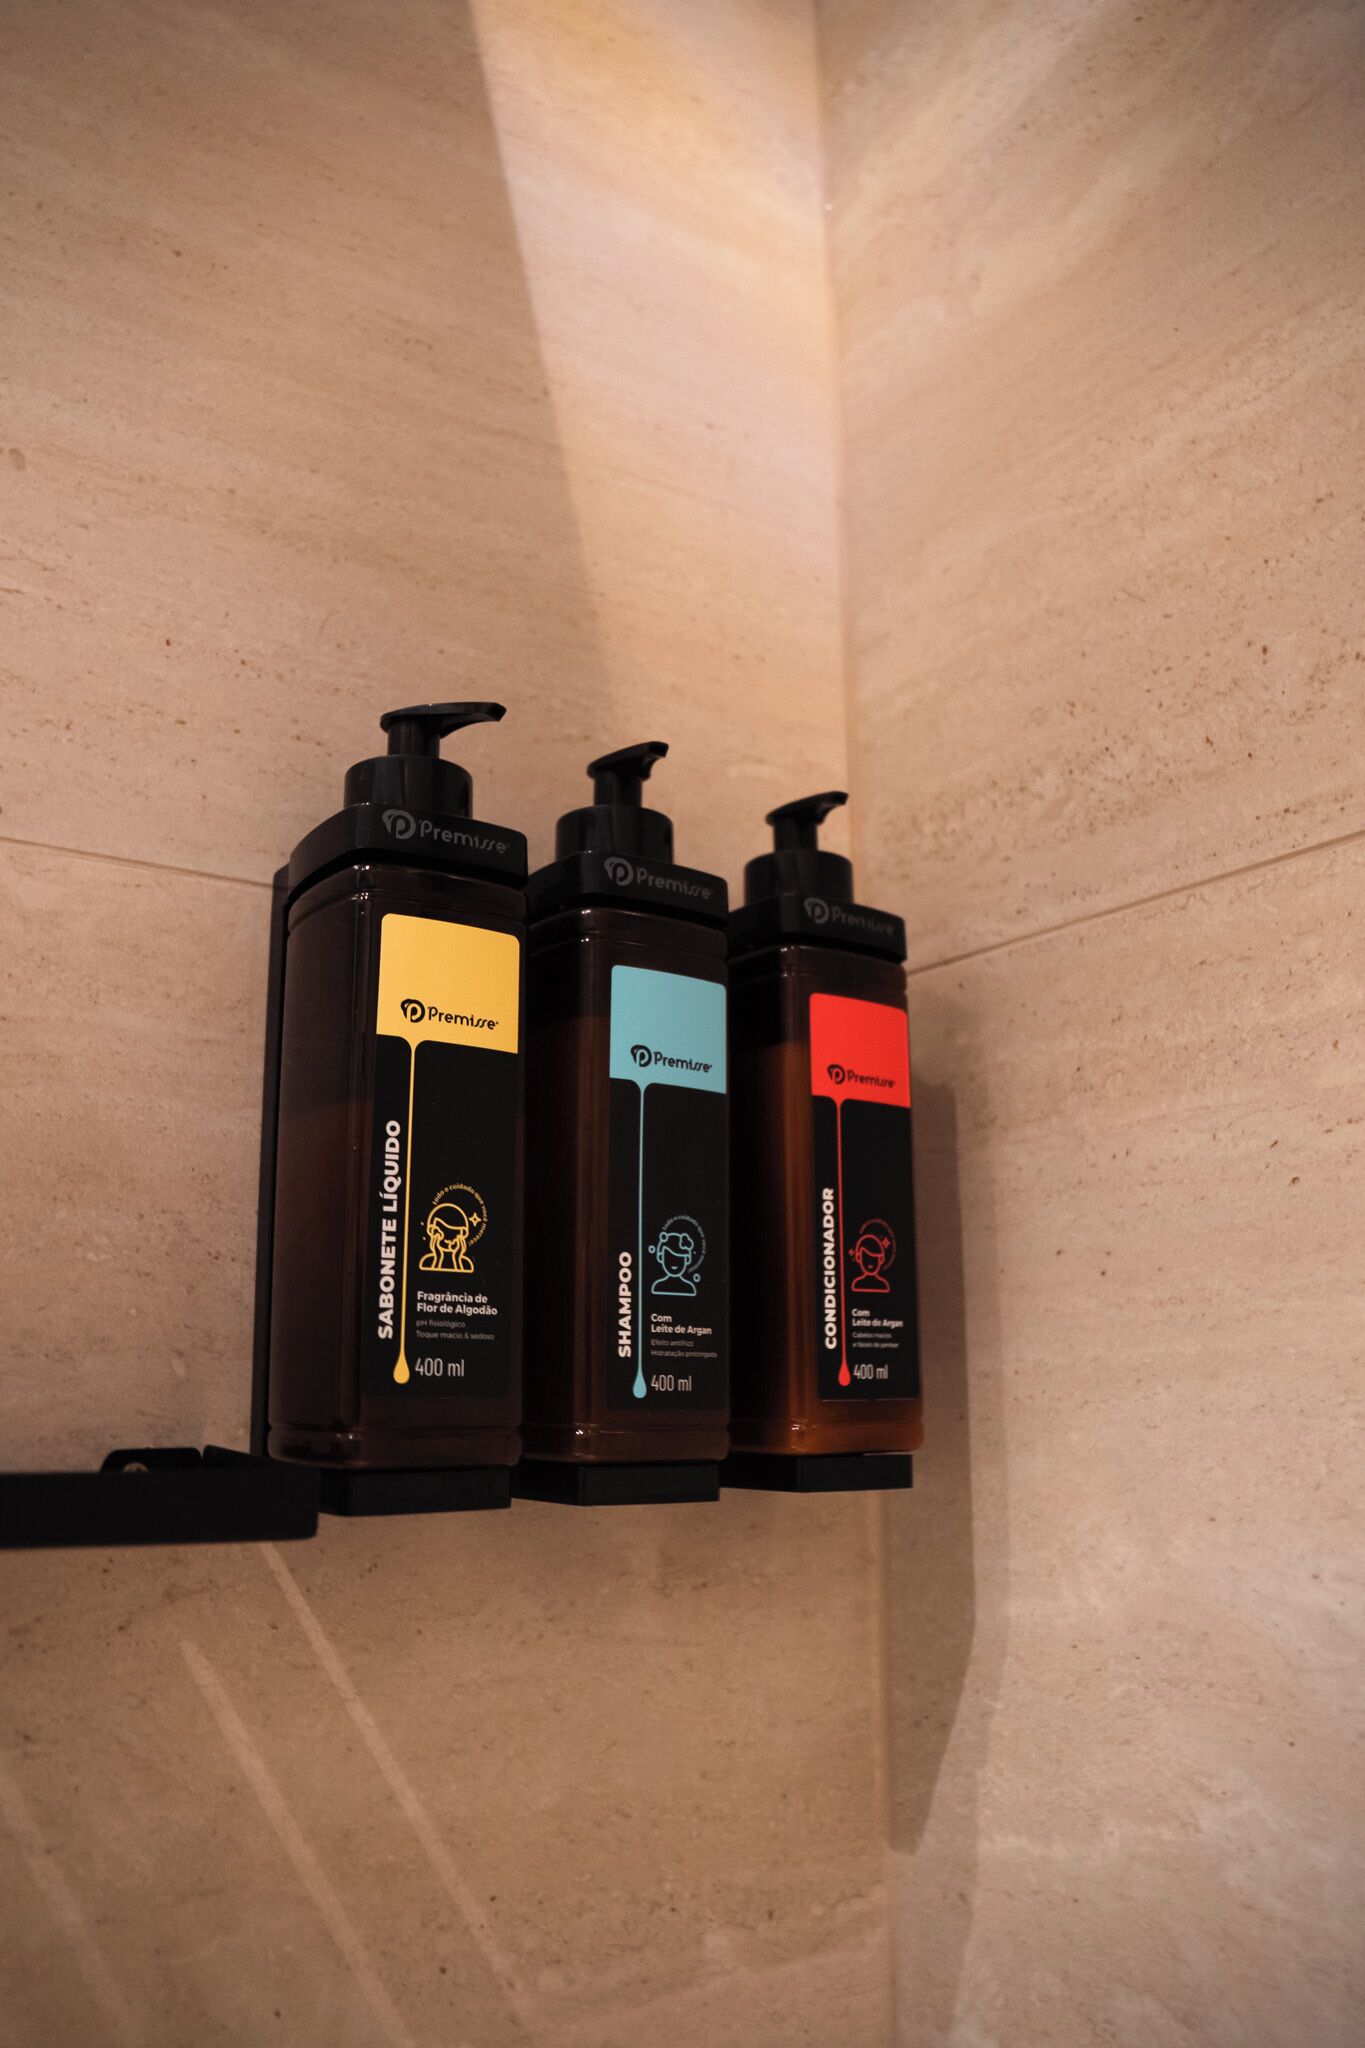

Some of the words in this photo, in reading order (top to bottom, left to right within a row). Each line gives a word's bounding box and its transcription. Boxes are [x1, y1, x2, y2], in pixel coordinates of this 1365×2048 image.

[419, 820, 507, 853] Premisse
[635, 866, 711, 899] Premisse
[428, 1006, 496, 1030] Premisse
[653, 1051, 710, 1073] Premisse
[847, 1069, 894, 1088] Premisse
[379, 1120, 402, 1212] LÍQUIDO
[822, 1187, 837, 1350] CONDICIONADOR
[378, 1218, 398, 1340] SABONETE
[417, 1290, 473, 1303] Fragrância
[475, 1293, 488, 1303] de
[618, 1251, 632, 1358] SHAMPOO
[417, 1302, 438, 1313] Flor
[440, 1303, 453, 1313] de
[455, 1304, 498, 1316] Algodão
[651, 1313, 672, 1322] Com
[852, 1308, 870, 1317] Com
[651, 1323, 673, 1333] Leite
[674, 1324, 685, 1334] de
[687, 1325, 712, 1336] Argan
[852, 1318, 871, 1327] Leite
[882, 1319, 904, 1329] Argan
[415, 1357, 443, 1377] 400
[447, 1358, 465, 1377] ml
[853, 1364, 874, 1379] 400
[876, 1364, 889, 1379] ml
[651, 1374, 675, 1391] 400
[677, 1375, 692, 1391] ml
